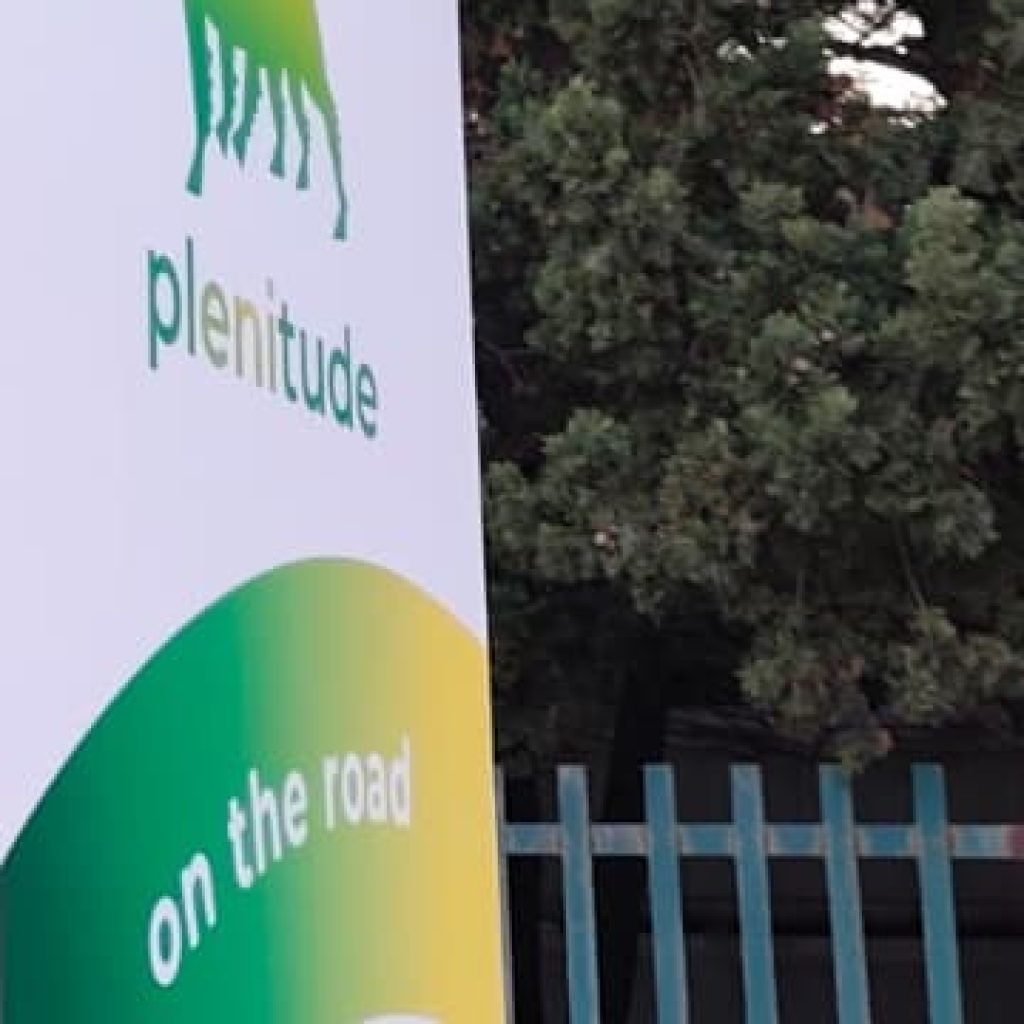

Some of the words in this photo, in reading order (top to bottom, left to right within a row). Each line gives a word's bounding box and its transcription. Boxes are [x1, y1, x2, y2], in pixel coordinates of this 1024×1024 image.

[147, 235, 378, 439] plenitude
[147, 852, 218, 988] on
[227, 767, 309, 889] the
[322, 733, 411, 831] road
